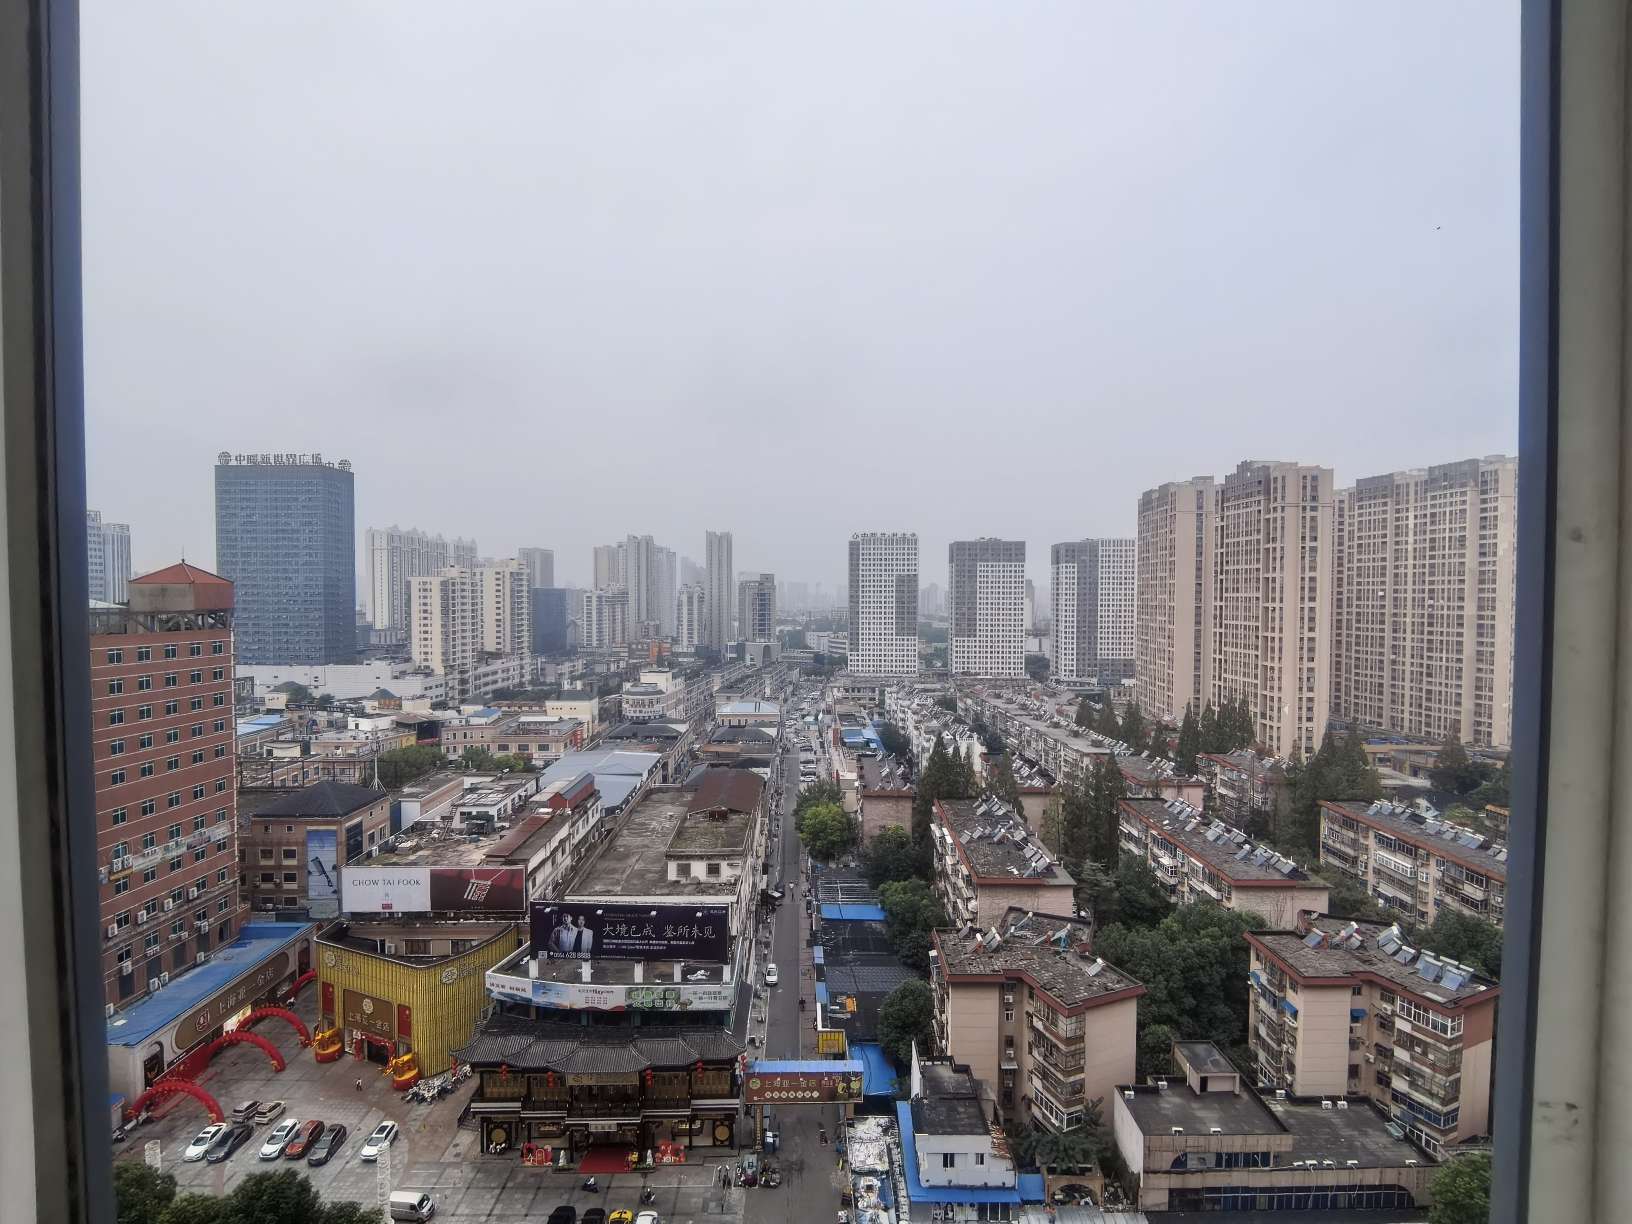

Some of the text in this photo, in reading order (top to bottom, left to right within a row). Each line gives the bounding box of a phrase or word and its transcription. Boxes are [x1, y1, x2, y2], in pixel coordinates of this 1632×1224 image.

[352, 879, 379, 887] CHOW
[397, 878, 421, 886] FOOK
[603, 923, 716, 939] 大境已成 鉴所未见
